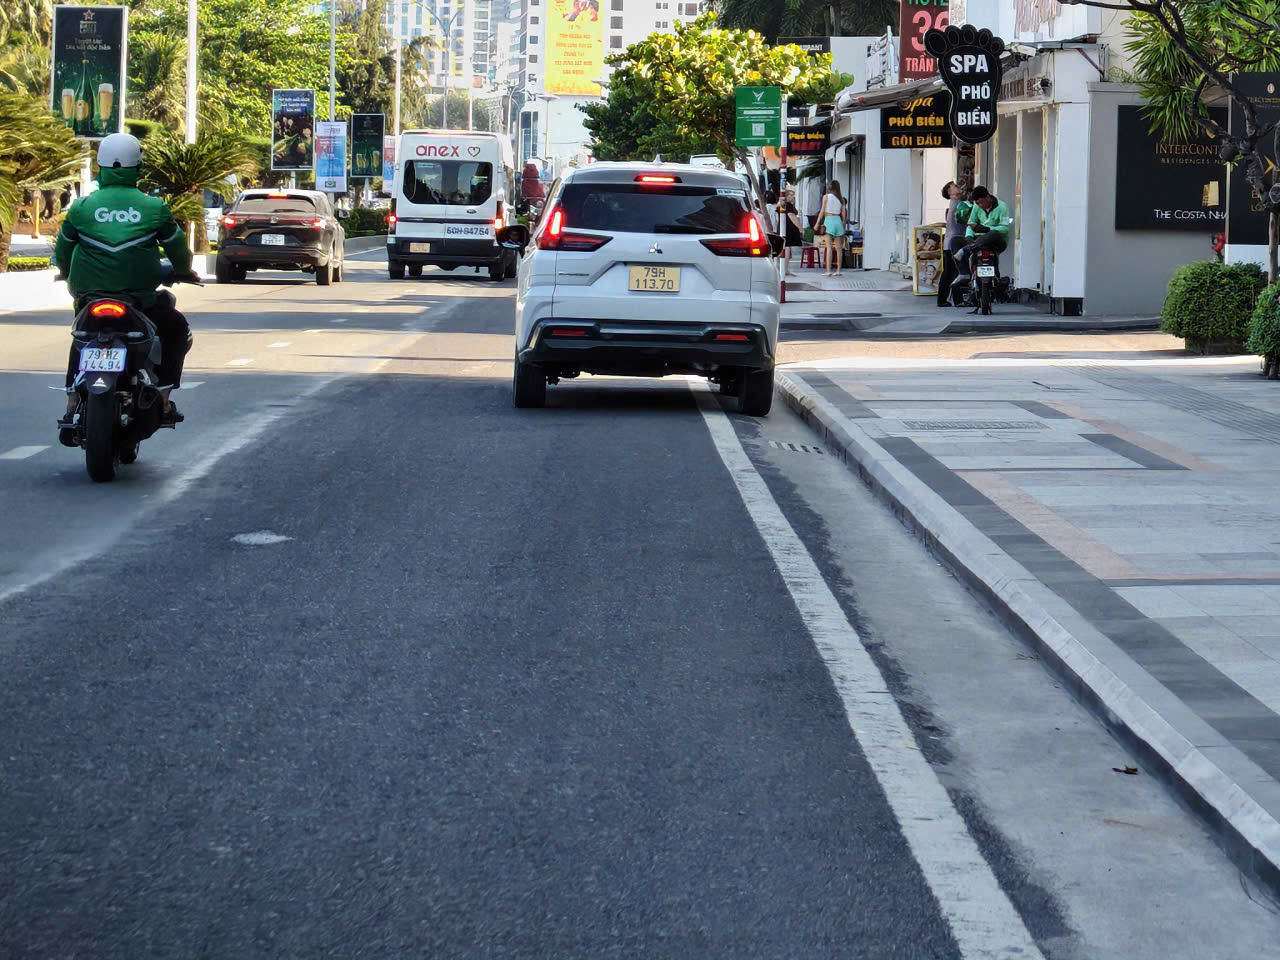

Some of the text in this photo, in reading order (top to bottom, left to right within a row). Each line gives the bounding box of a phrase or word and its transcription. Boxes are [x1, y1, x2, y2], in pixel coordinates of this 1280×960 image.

[950, 54, 989, 74] SPA
[961, 80, 991, 100] PHỐ
[957, 106, 991, 126] BIỂN
[416, 144, 460, 157] anex
[94, 206, 142, 223] Grab
[1153, 209, 1172, 219] THE
[1174, 209, 1207, 220] COSTA
[643, 267, 666, 278] 79H
[635, 278, 674, 290] 113.70
